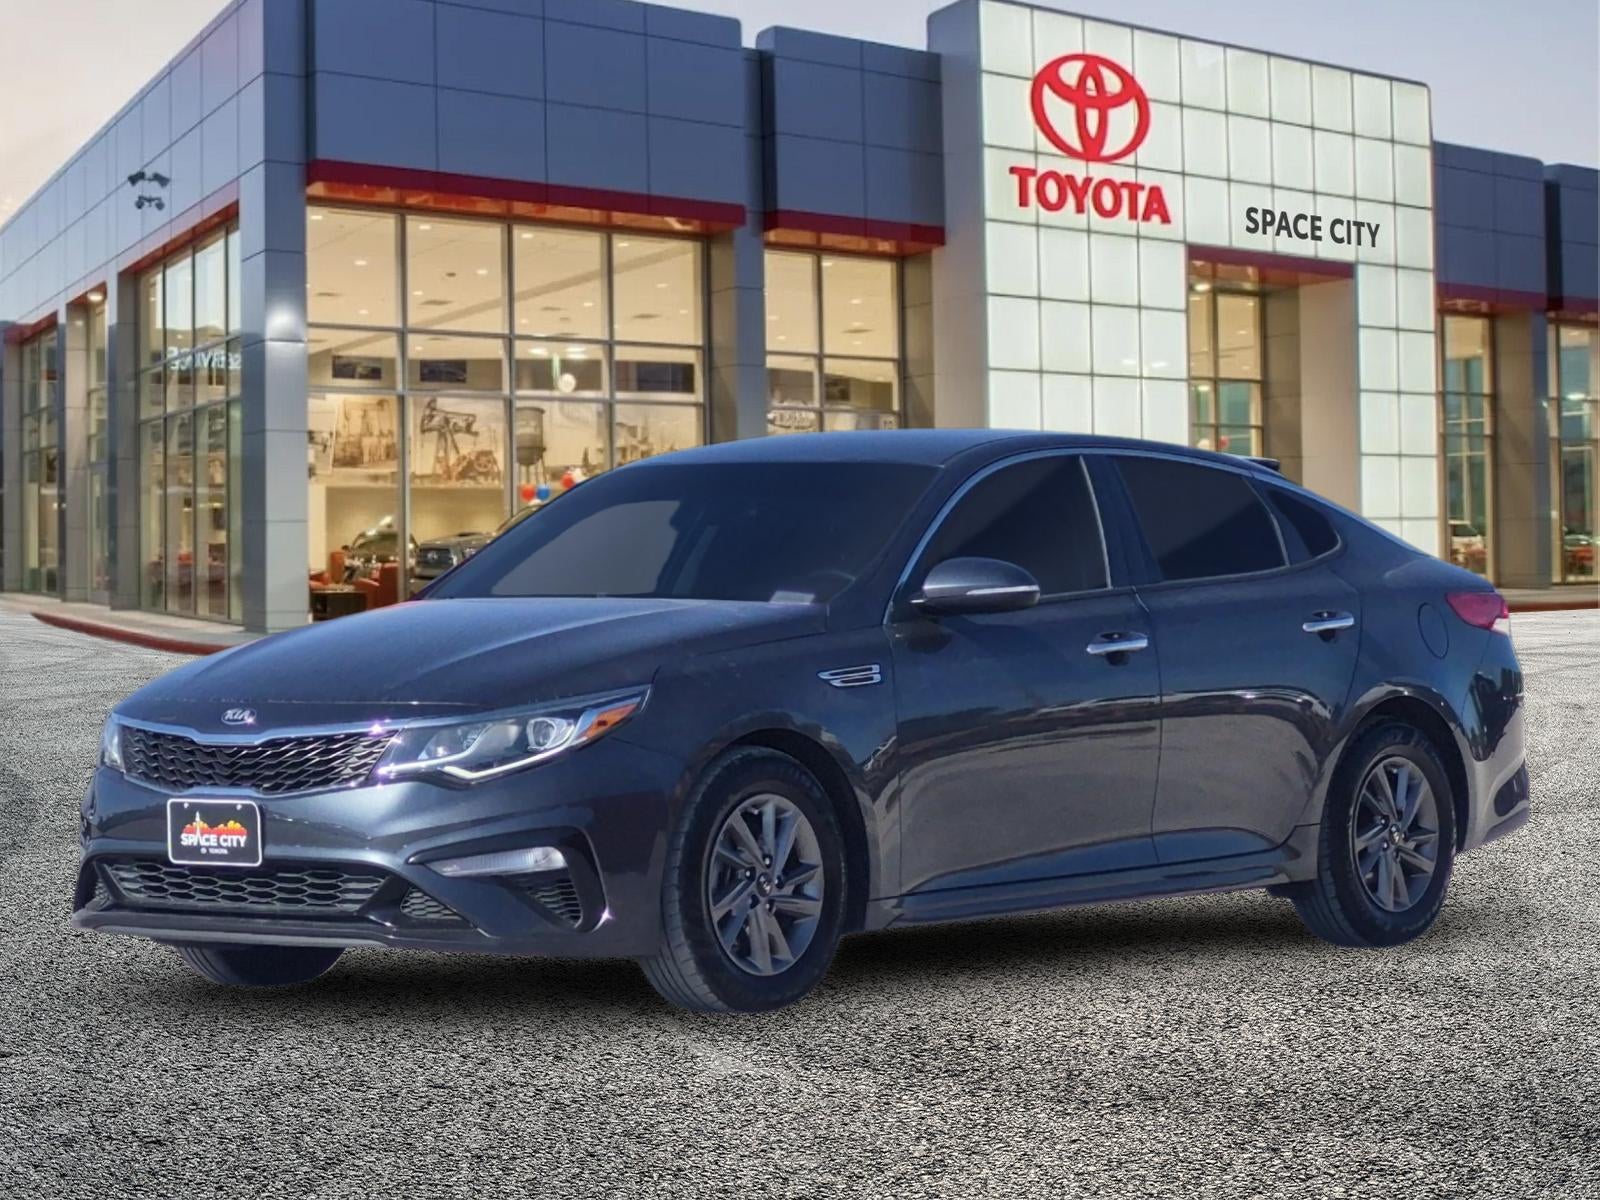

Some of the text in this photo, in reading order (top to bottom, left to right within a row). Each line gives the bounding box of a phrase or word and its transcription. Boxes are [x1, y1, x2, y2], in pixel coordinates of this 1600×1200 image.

[1009, 166, 1171, 224] TOYOTA
[1245, 206, 1380, 248] SPACE CITY
[224, 709, 251, 721] KIA
[180, 833, 247, 848] SPACE CITY
